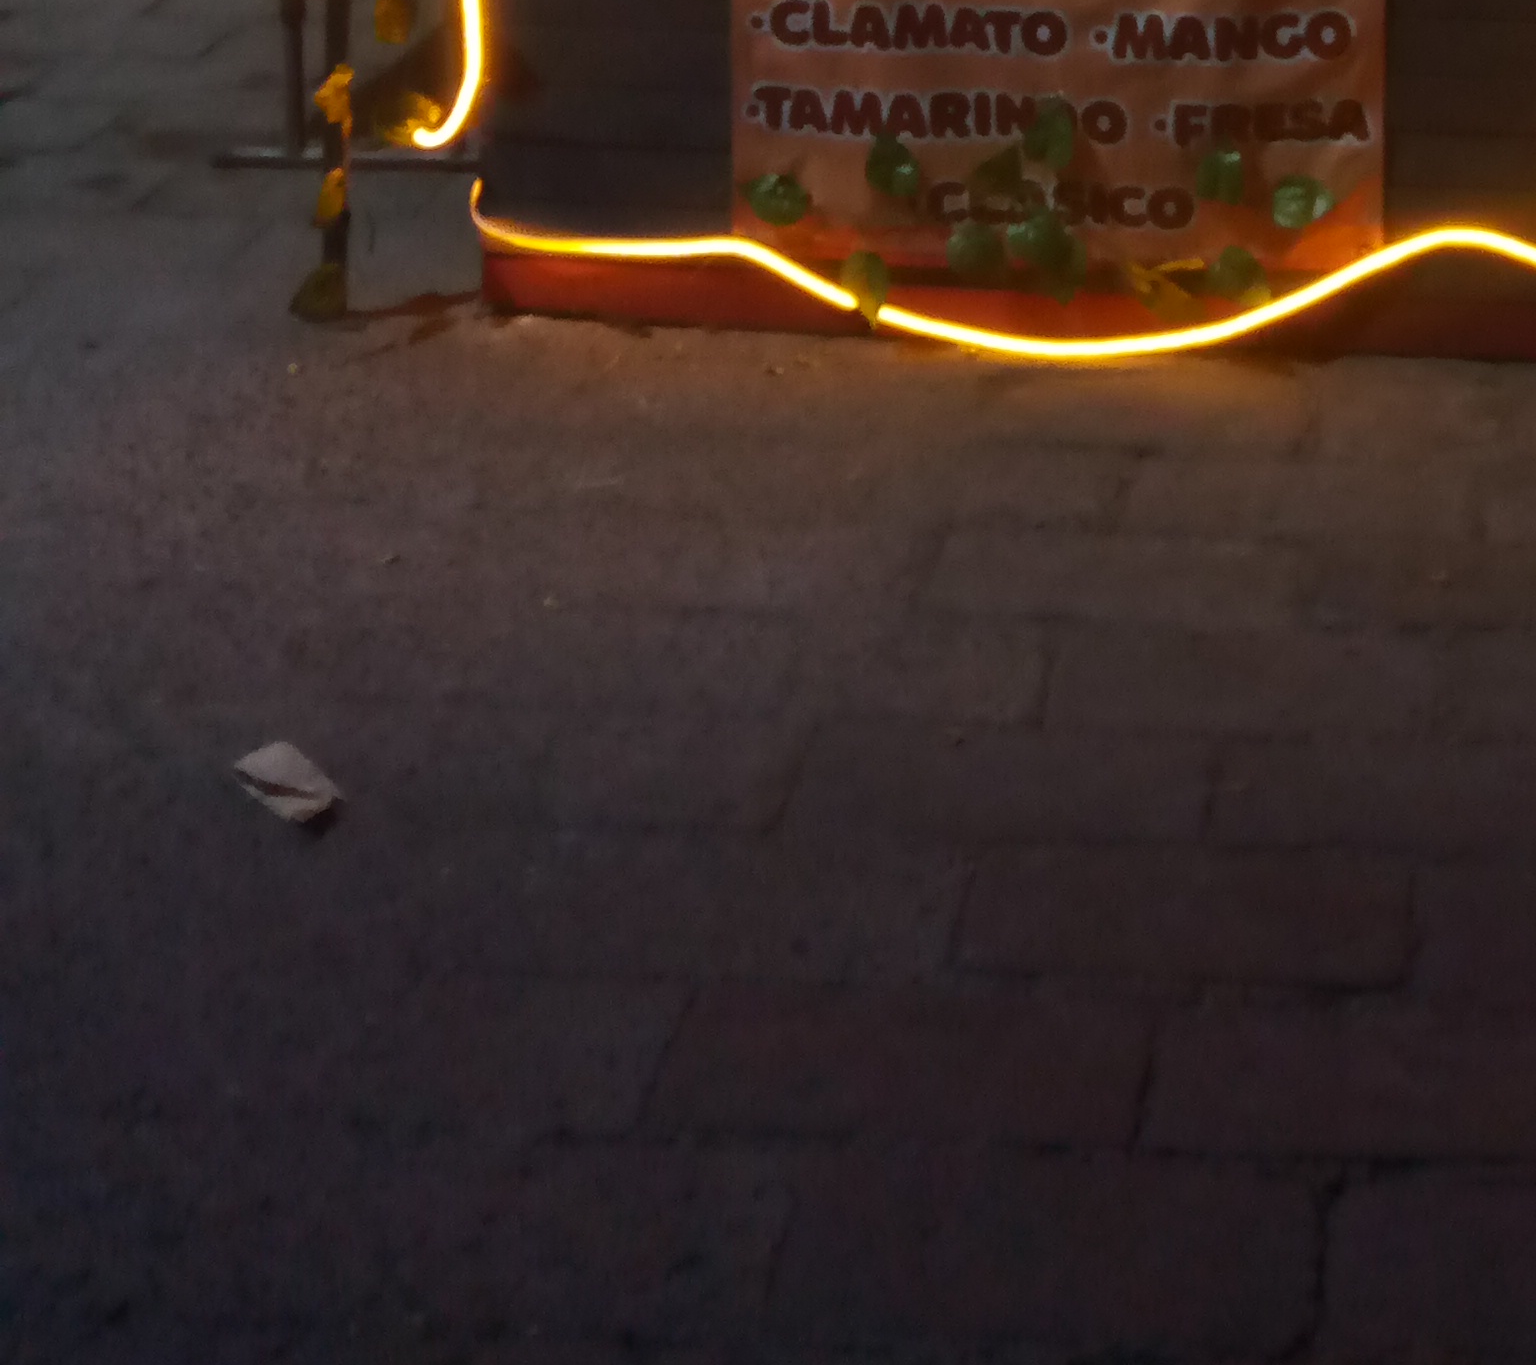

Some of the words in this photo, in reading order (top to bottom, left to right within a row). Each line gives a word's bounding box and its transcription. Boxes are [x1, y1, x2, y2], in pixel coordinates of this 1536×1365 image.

[770, 0, 1068, 56] CLAMATO
[1112, 12, 1352, 61] MANGO
[756, 86, 1129, 145] TAMARINO
[1174, 98, 1370, 147] FRESA
